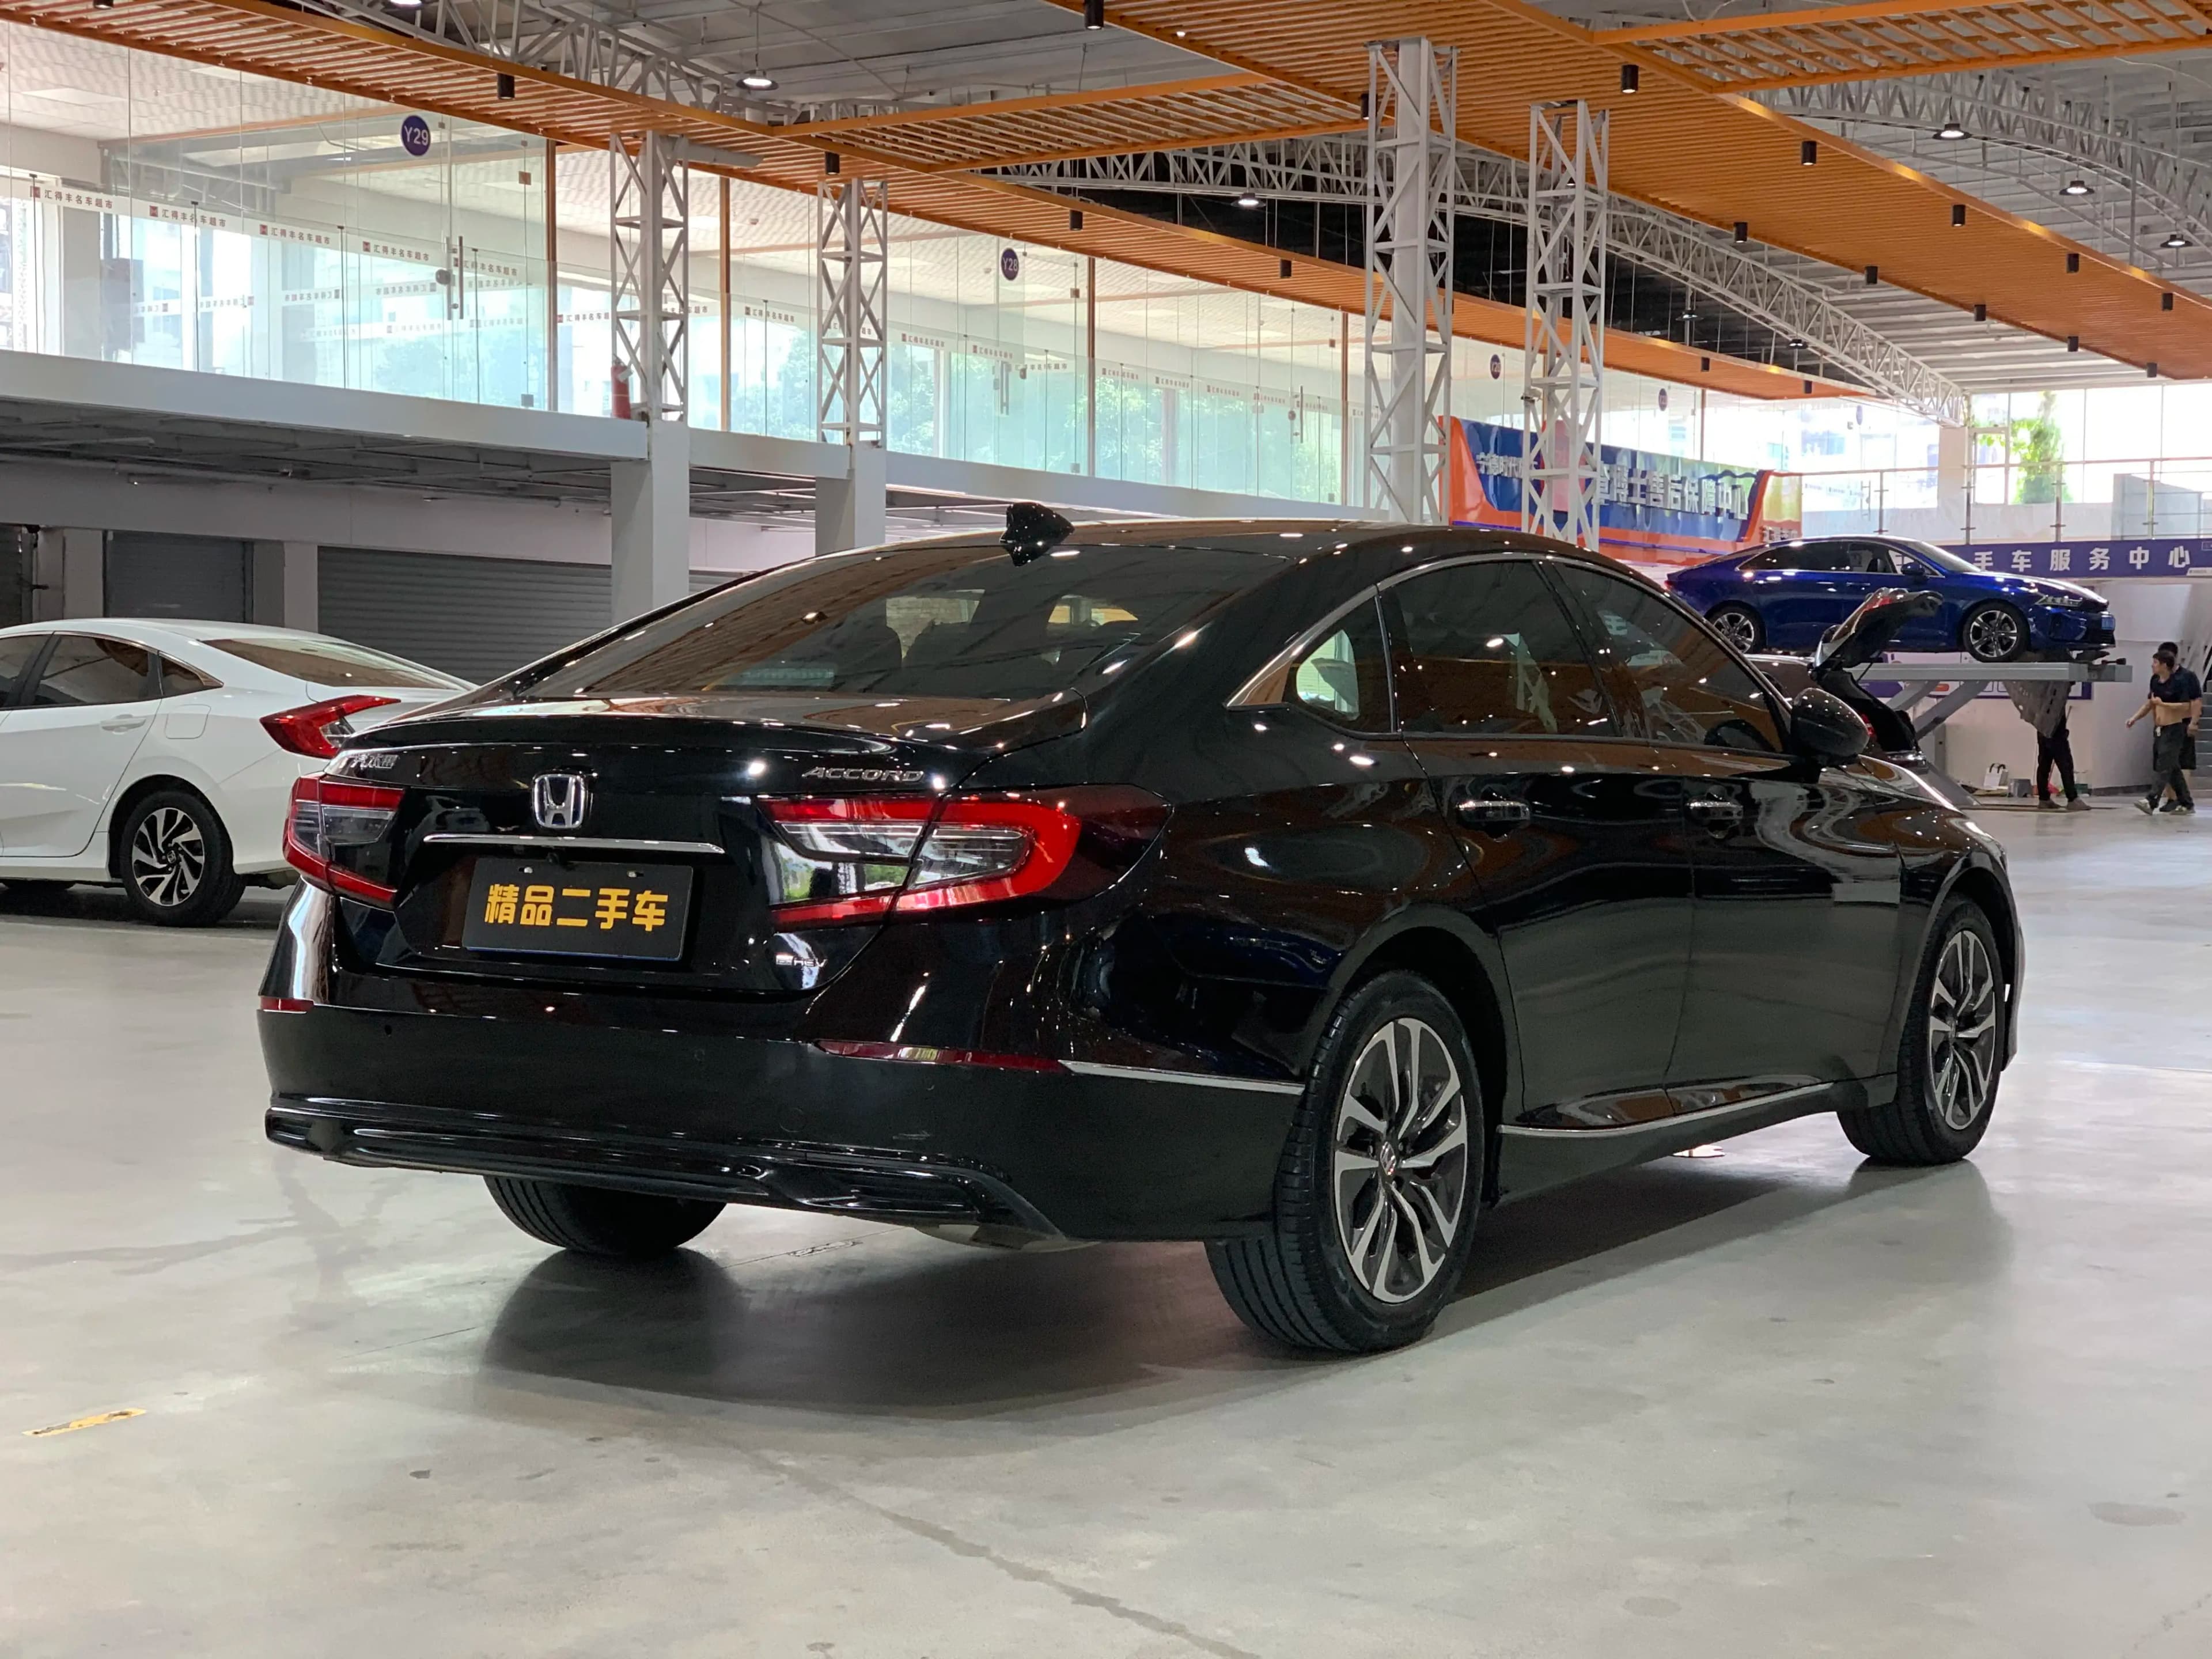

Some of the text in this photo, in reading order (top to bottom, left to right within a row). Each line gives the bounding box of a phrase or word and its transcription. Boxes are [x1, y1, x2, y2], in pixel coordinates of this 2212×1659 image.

[404, 126, 429, 146] Y29
[1003, 257, 1018, 271] Y28
[801, 767, 925, 782] ACCORD
[484, 884, 668, 931] 精品二手车
